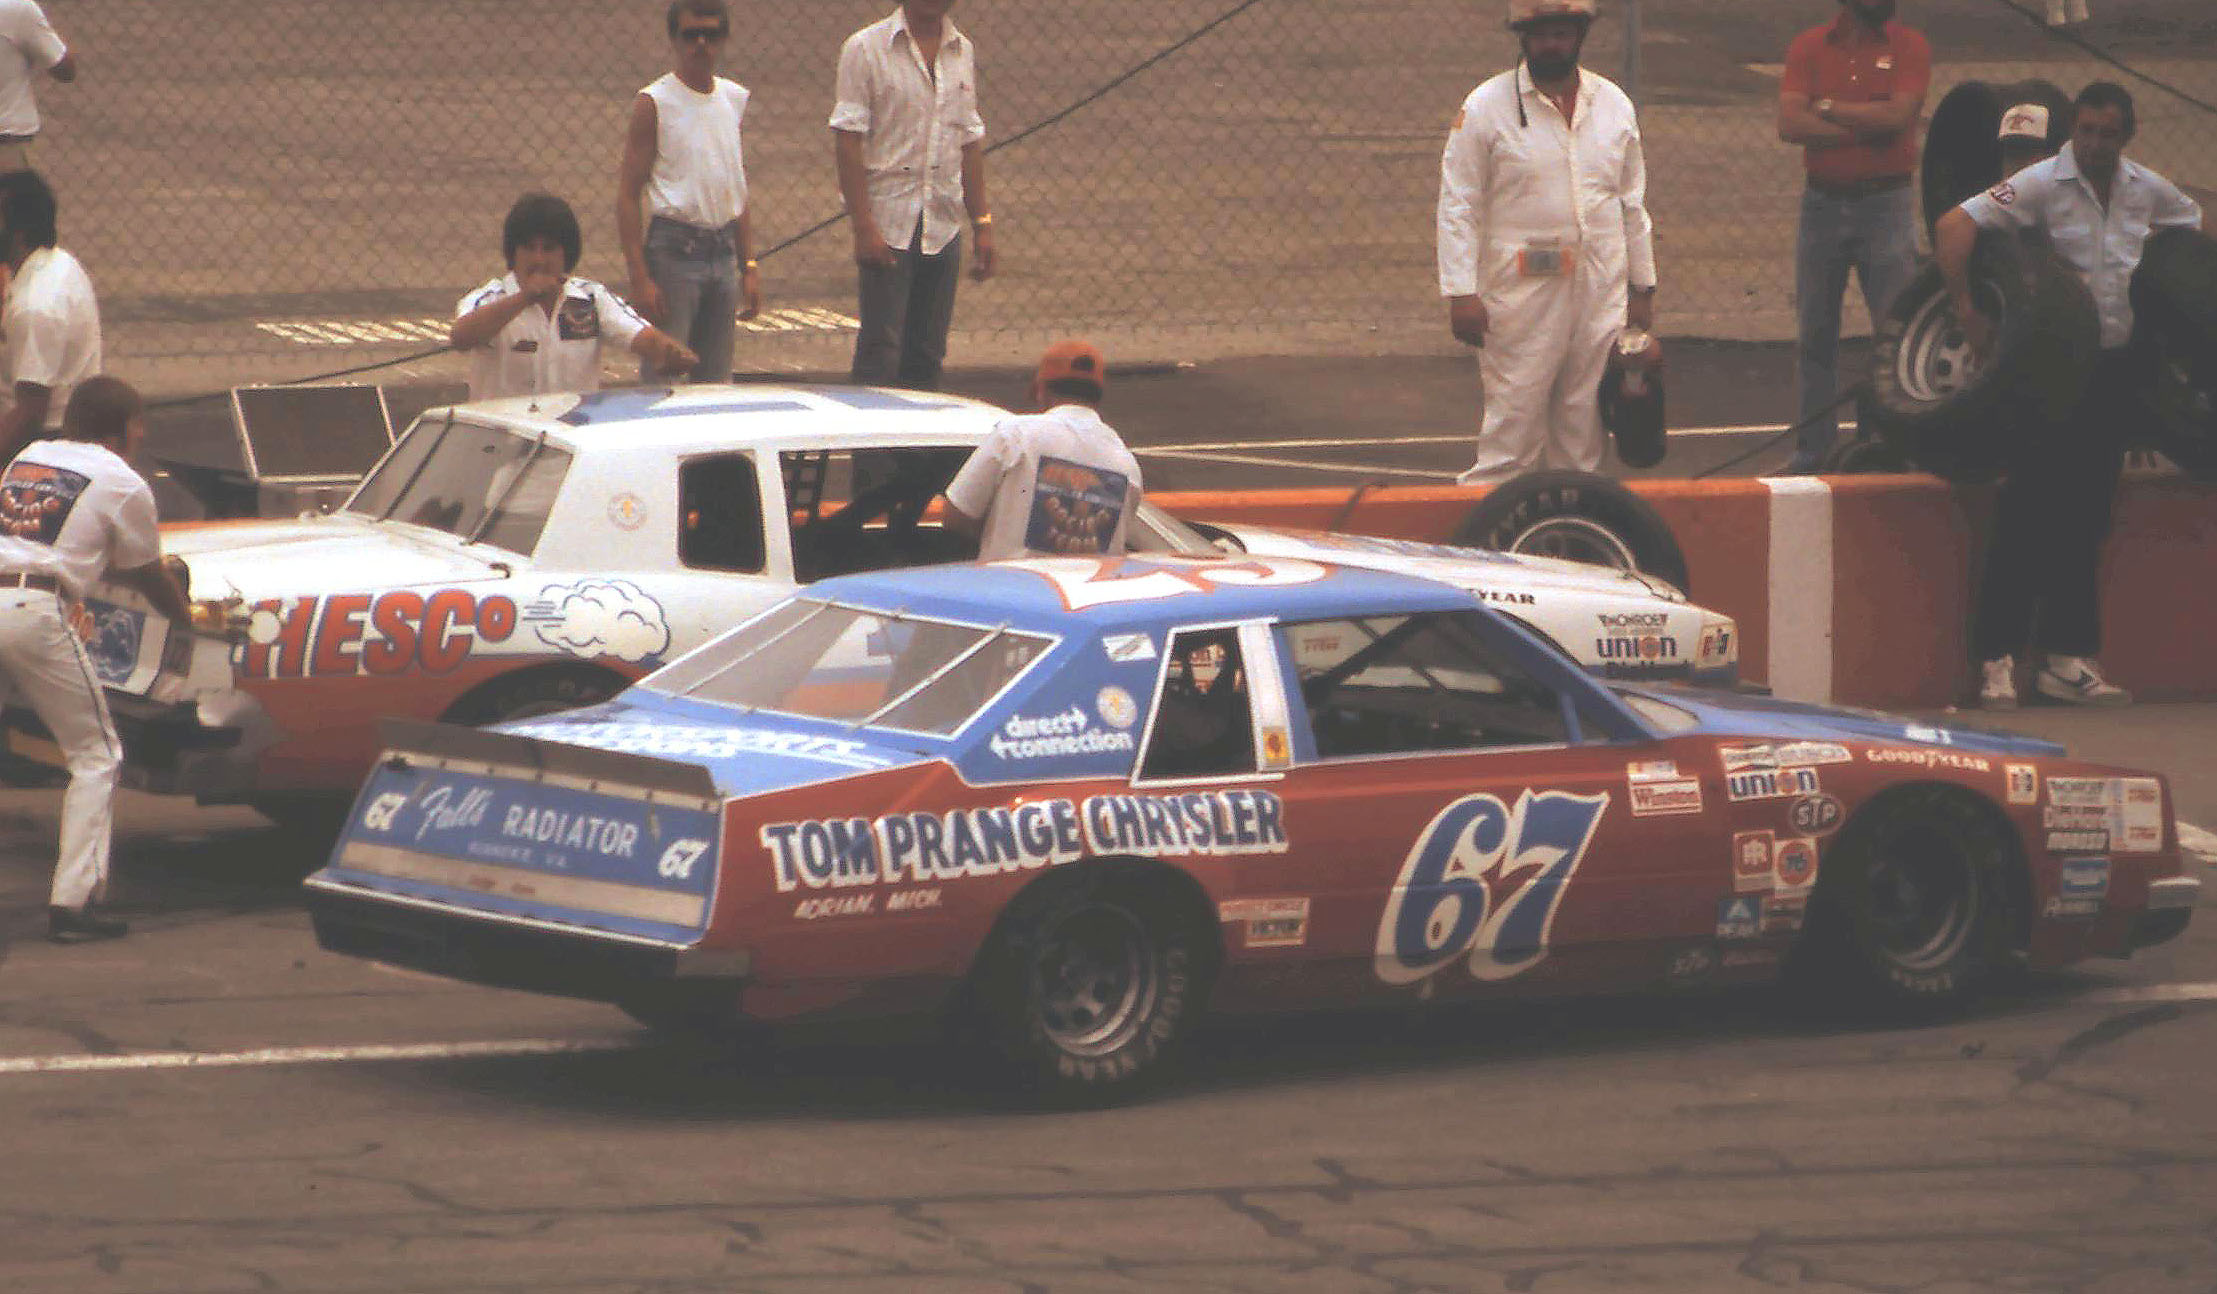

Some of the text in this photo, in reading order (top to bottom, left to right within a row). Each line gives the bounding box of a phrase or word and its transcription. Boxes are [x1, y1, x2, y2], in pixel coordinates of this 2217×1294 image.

[364, 792, 407, 830] 67
[501, 803, 640, 858] RADIATOR
[760, 790, 1289, 893] TOM PRANGE CHRYSLER
[1798, 798, 1837, 827] STP
[657, 838, 710, 879] 67
[1373, 786, 1610, 984] 67
